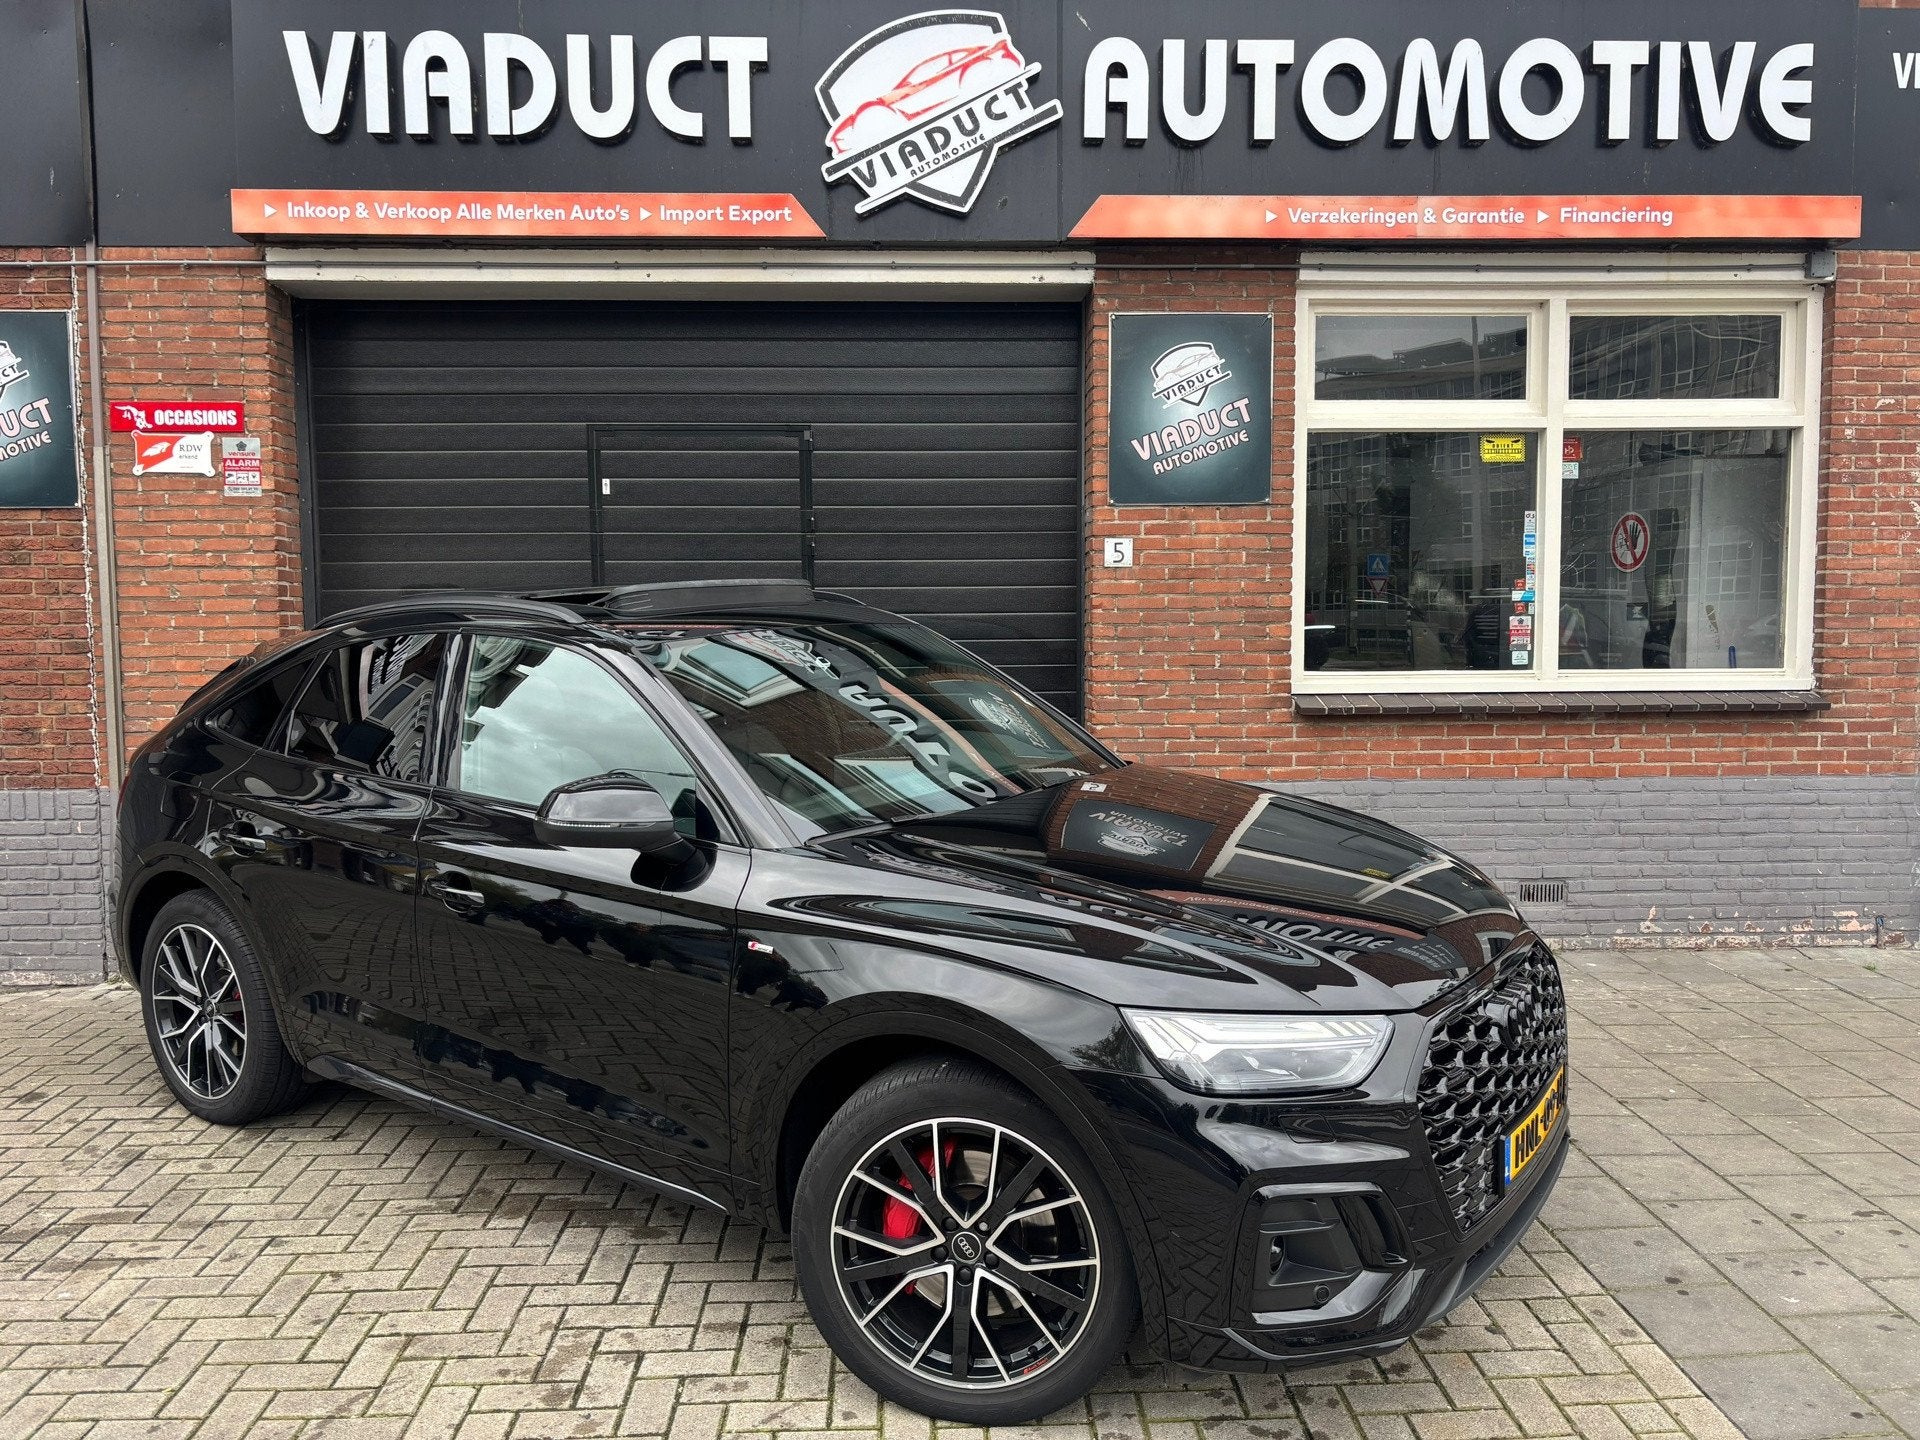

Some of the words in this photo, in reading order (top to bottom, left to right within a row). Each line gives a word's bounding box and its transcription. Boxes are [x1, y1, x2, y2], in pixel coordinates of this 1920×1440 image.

[283, 29, 768, 140] VIADUCT
[1083, 37, 1815, 142] AUTOMOTIVE
[851, 82, 1028, 188] VIADUCT
[910, 133, 986, 178] AUTOMOTIVE
[287, 202, 351, 222] Inkoop
[355, 202, 370, 219] &
[374, 202, 451, 223] Verkoop
[456, 203, 493, 220] Alle
[496, 204, 566, 221] Merken
[570, 204, 630, 221] Auto's
[660, 205, 724, 225] Import
[728, 205, 793, 225] Export
[1287, 207, 1419, 227] Verzekeringen
[1423, 207, 1437, 224] &
[1442, 207, 1525, 225] Garantie
[1560, 207, 1673, 226] Financiering
[1162, 365, 1220, 401] VIADUCT
[154, 409, 238, 426] OCCASIONS
[1131, 398, 1251, 461] VIADUCT
[179, 444, 203, 452] RDW
[1153, 429, 1249, 475] AUTOMOTIVE
[225, 459, 260, 467] ALARM
[1112, 542, 1125, 563] 5
